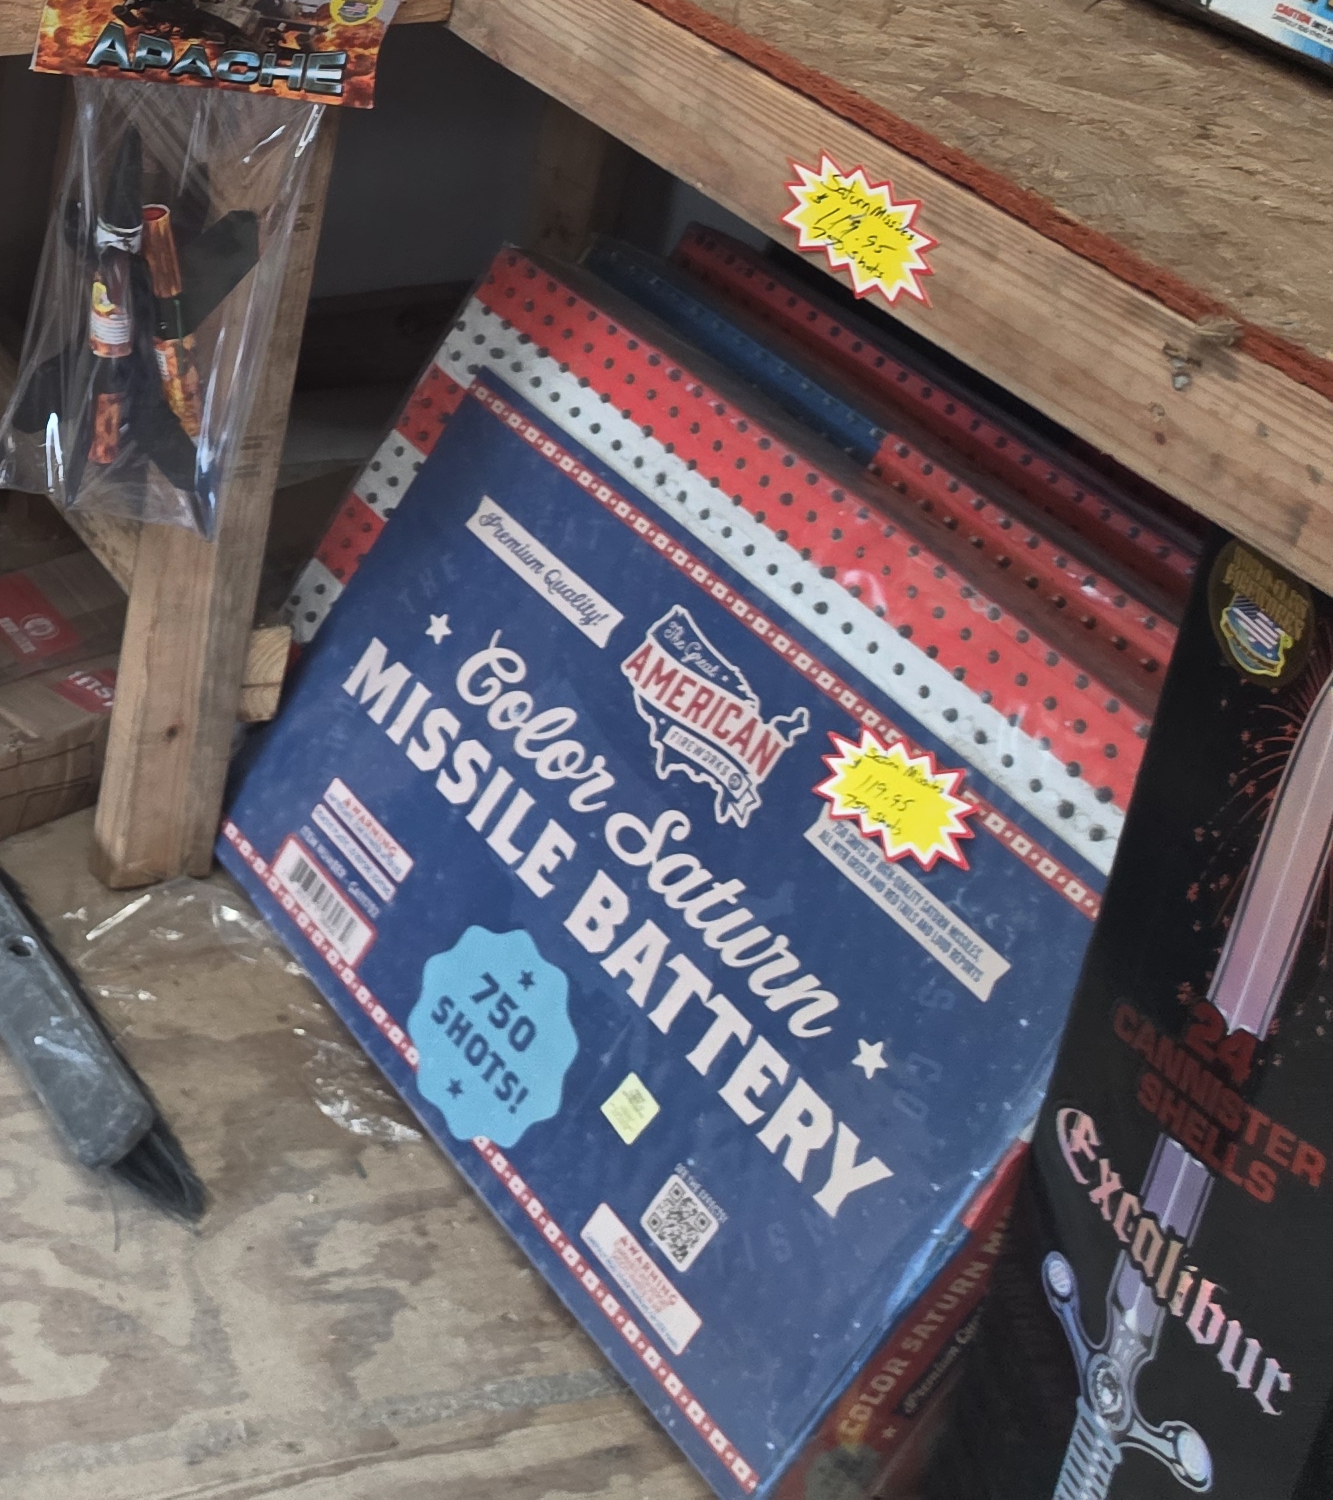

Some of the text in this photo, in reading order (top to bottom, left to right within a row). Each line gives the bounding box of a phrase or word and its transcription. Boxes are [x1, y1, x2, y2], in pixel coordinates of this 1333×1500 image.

[85, 20, 348, 98] APACHE
[478, 510, 610, 627] Premium Quality!
[624, 642, 783, 778] AMERICAN
[668, 730, 731, 778] FIREWORKS
[456, 629, 845, 1040] Color Saturn
[341, 636, 896, 1220] MISSILE BATTERY
[430, 995, 530, 1116] SHOTS!
[469, 971, 537, 1053] 750
[1183, 1001, 1261, 1083] 24
[1111, 1002, 1327, 1191] CANNISTER
[1136, 1071, 1279, 1204] SHELLS
[837, 1260, 989, 1437] COLOR SATURN
